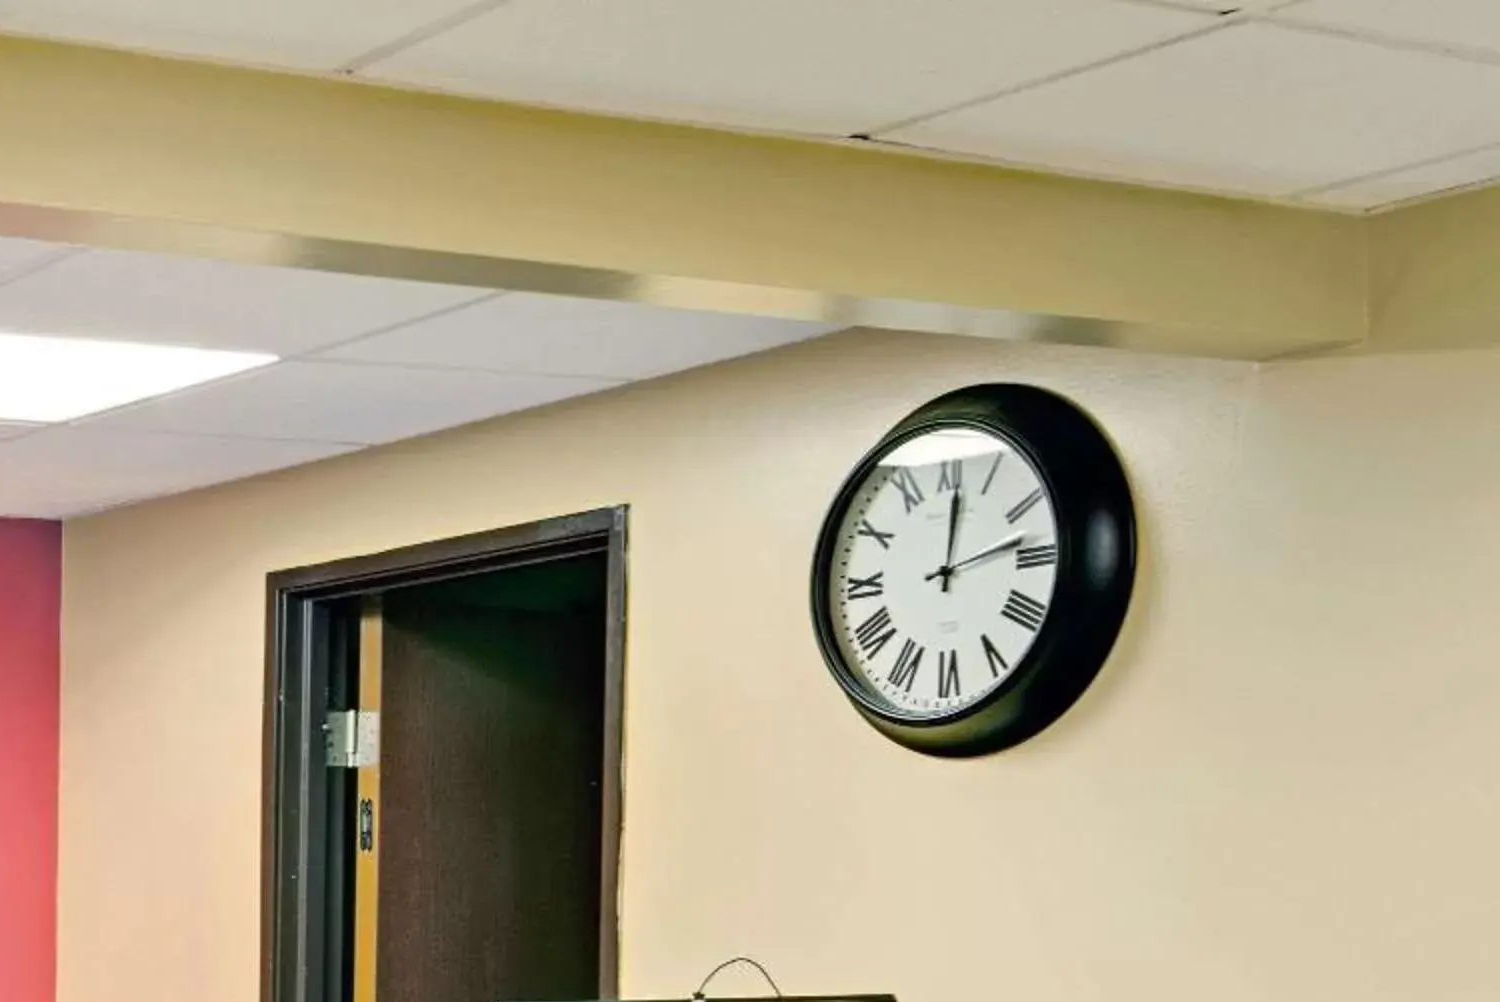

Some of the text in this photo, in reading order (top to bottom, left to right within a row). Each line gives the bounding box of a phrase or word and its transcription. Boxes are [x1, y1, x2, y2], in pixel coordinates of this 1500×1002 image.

[890, 467, 926, 514] XI
[857, 518, 895, 550] X
[1015, 544, 1057, 570] III
[846, 571, 884, 601] IX
[854, 605, 898, 661] VIII
[979, 633, 1009, 679] V
[887, 637, 926, 693] VII
[937, 648, 961, 699] VI
